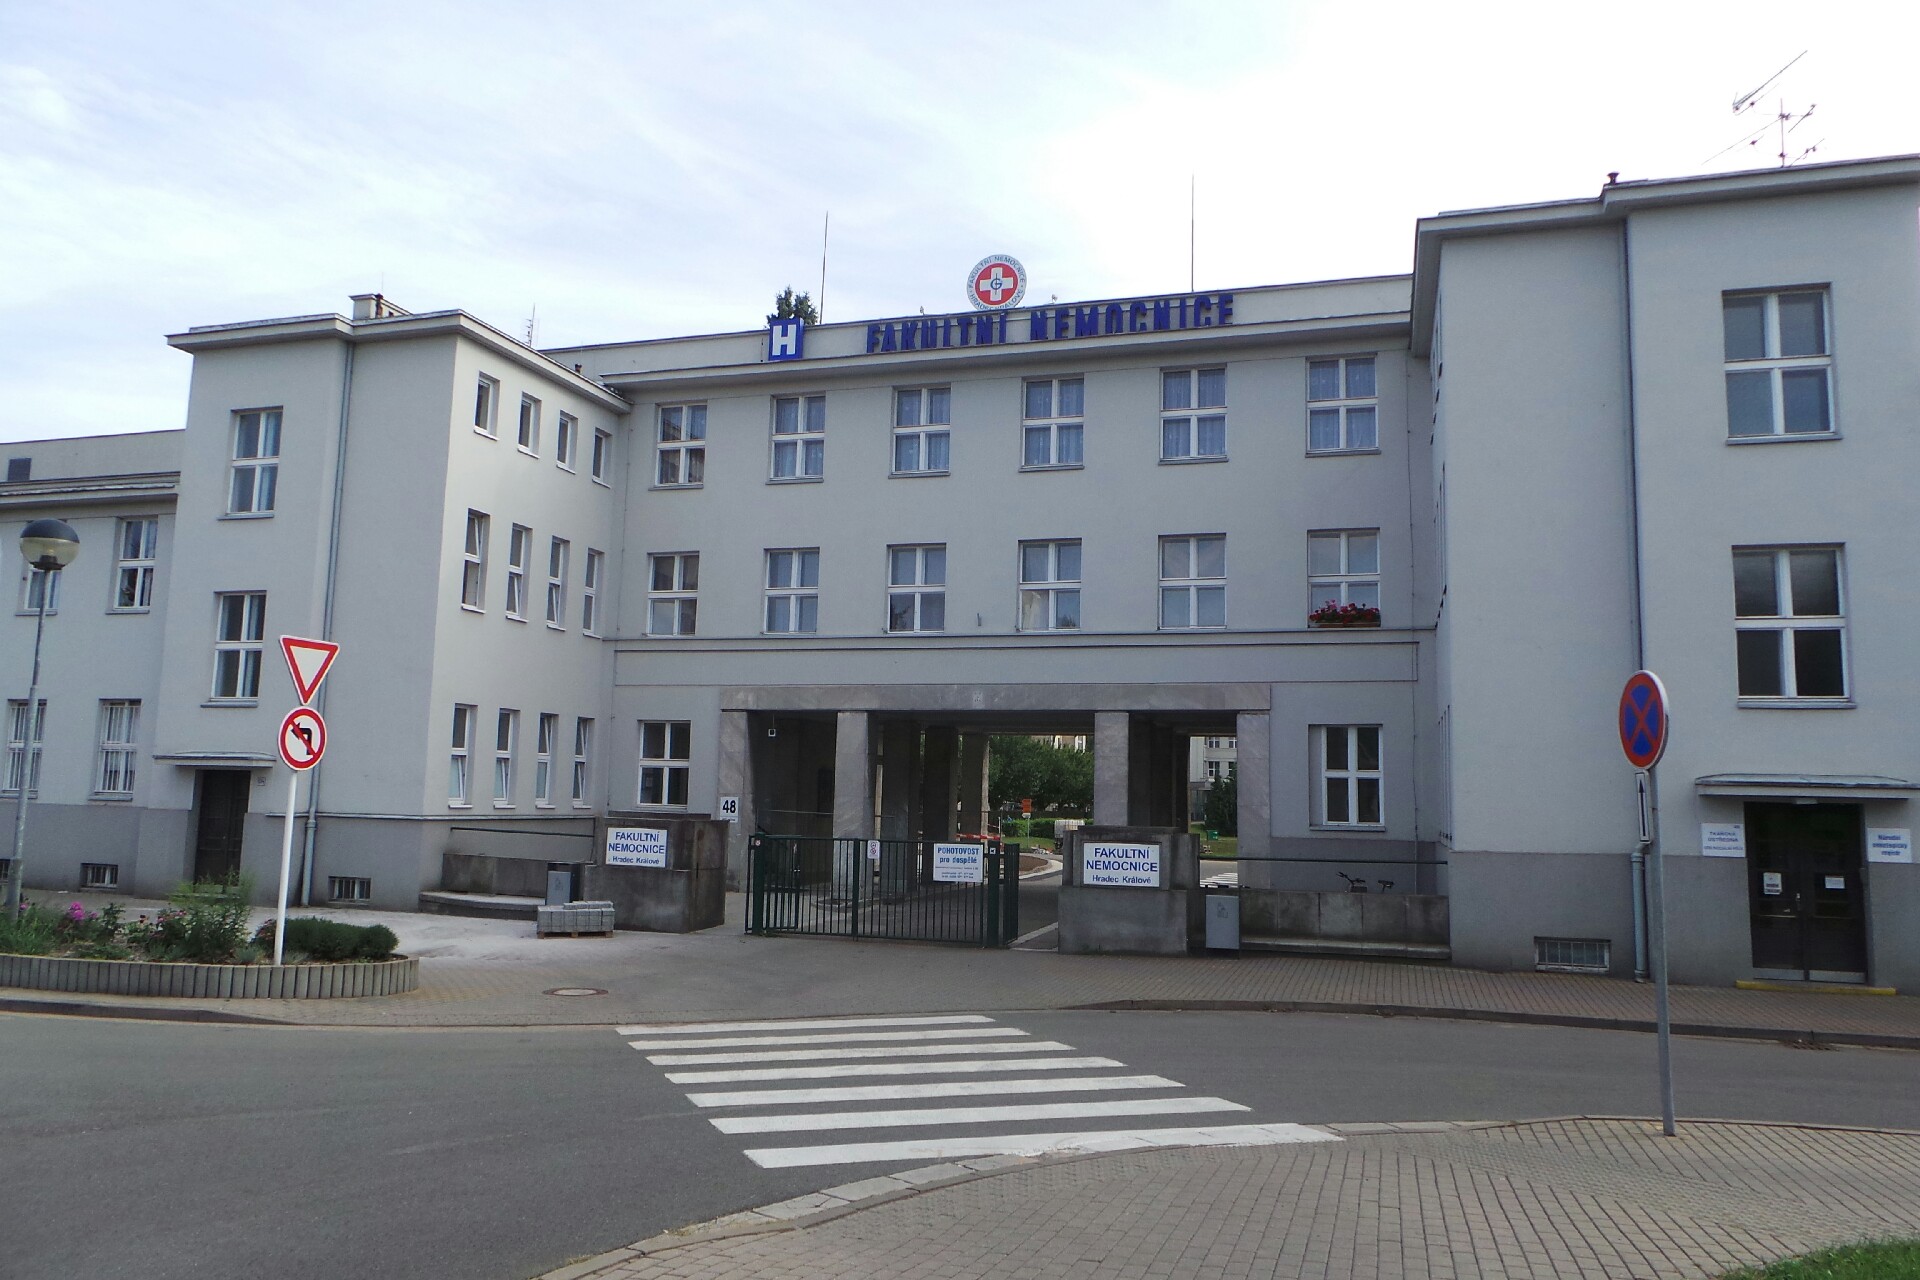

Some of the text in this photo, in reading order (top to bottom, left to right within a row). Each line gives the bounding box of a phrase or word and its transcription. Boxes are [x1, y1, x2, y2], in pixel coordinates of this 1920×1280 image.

[1030, 294, 1234, 341] NEMOCNICE
[772, 324, 797, 356] H
[722, 799, 736, 814] 48
[615, 831, 660, 842] FAKULTNÍ
[608, 843, 665, 854] NEMOCNICE
[937, 847, 980, 855] POHOTOVOST
[1094, 846, 1150, 859] FAKULTNÍ
[612, 856, 660, 865] Hradec Králové
[952, 856, 977, 865] dospělé
[1086, 860, 1158, 872] NEMOCNICE
[1092, 874, 1152, 884] Hradec Králové
